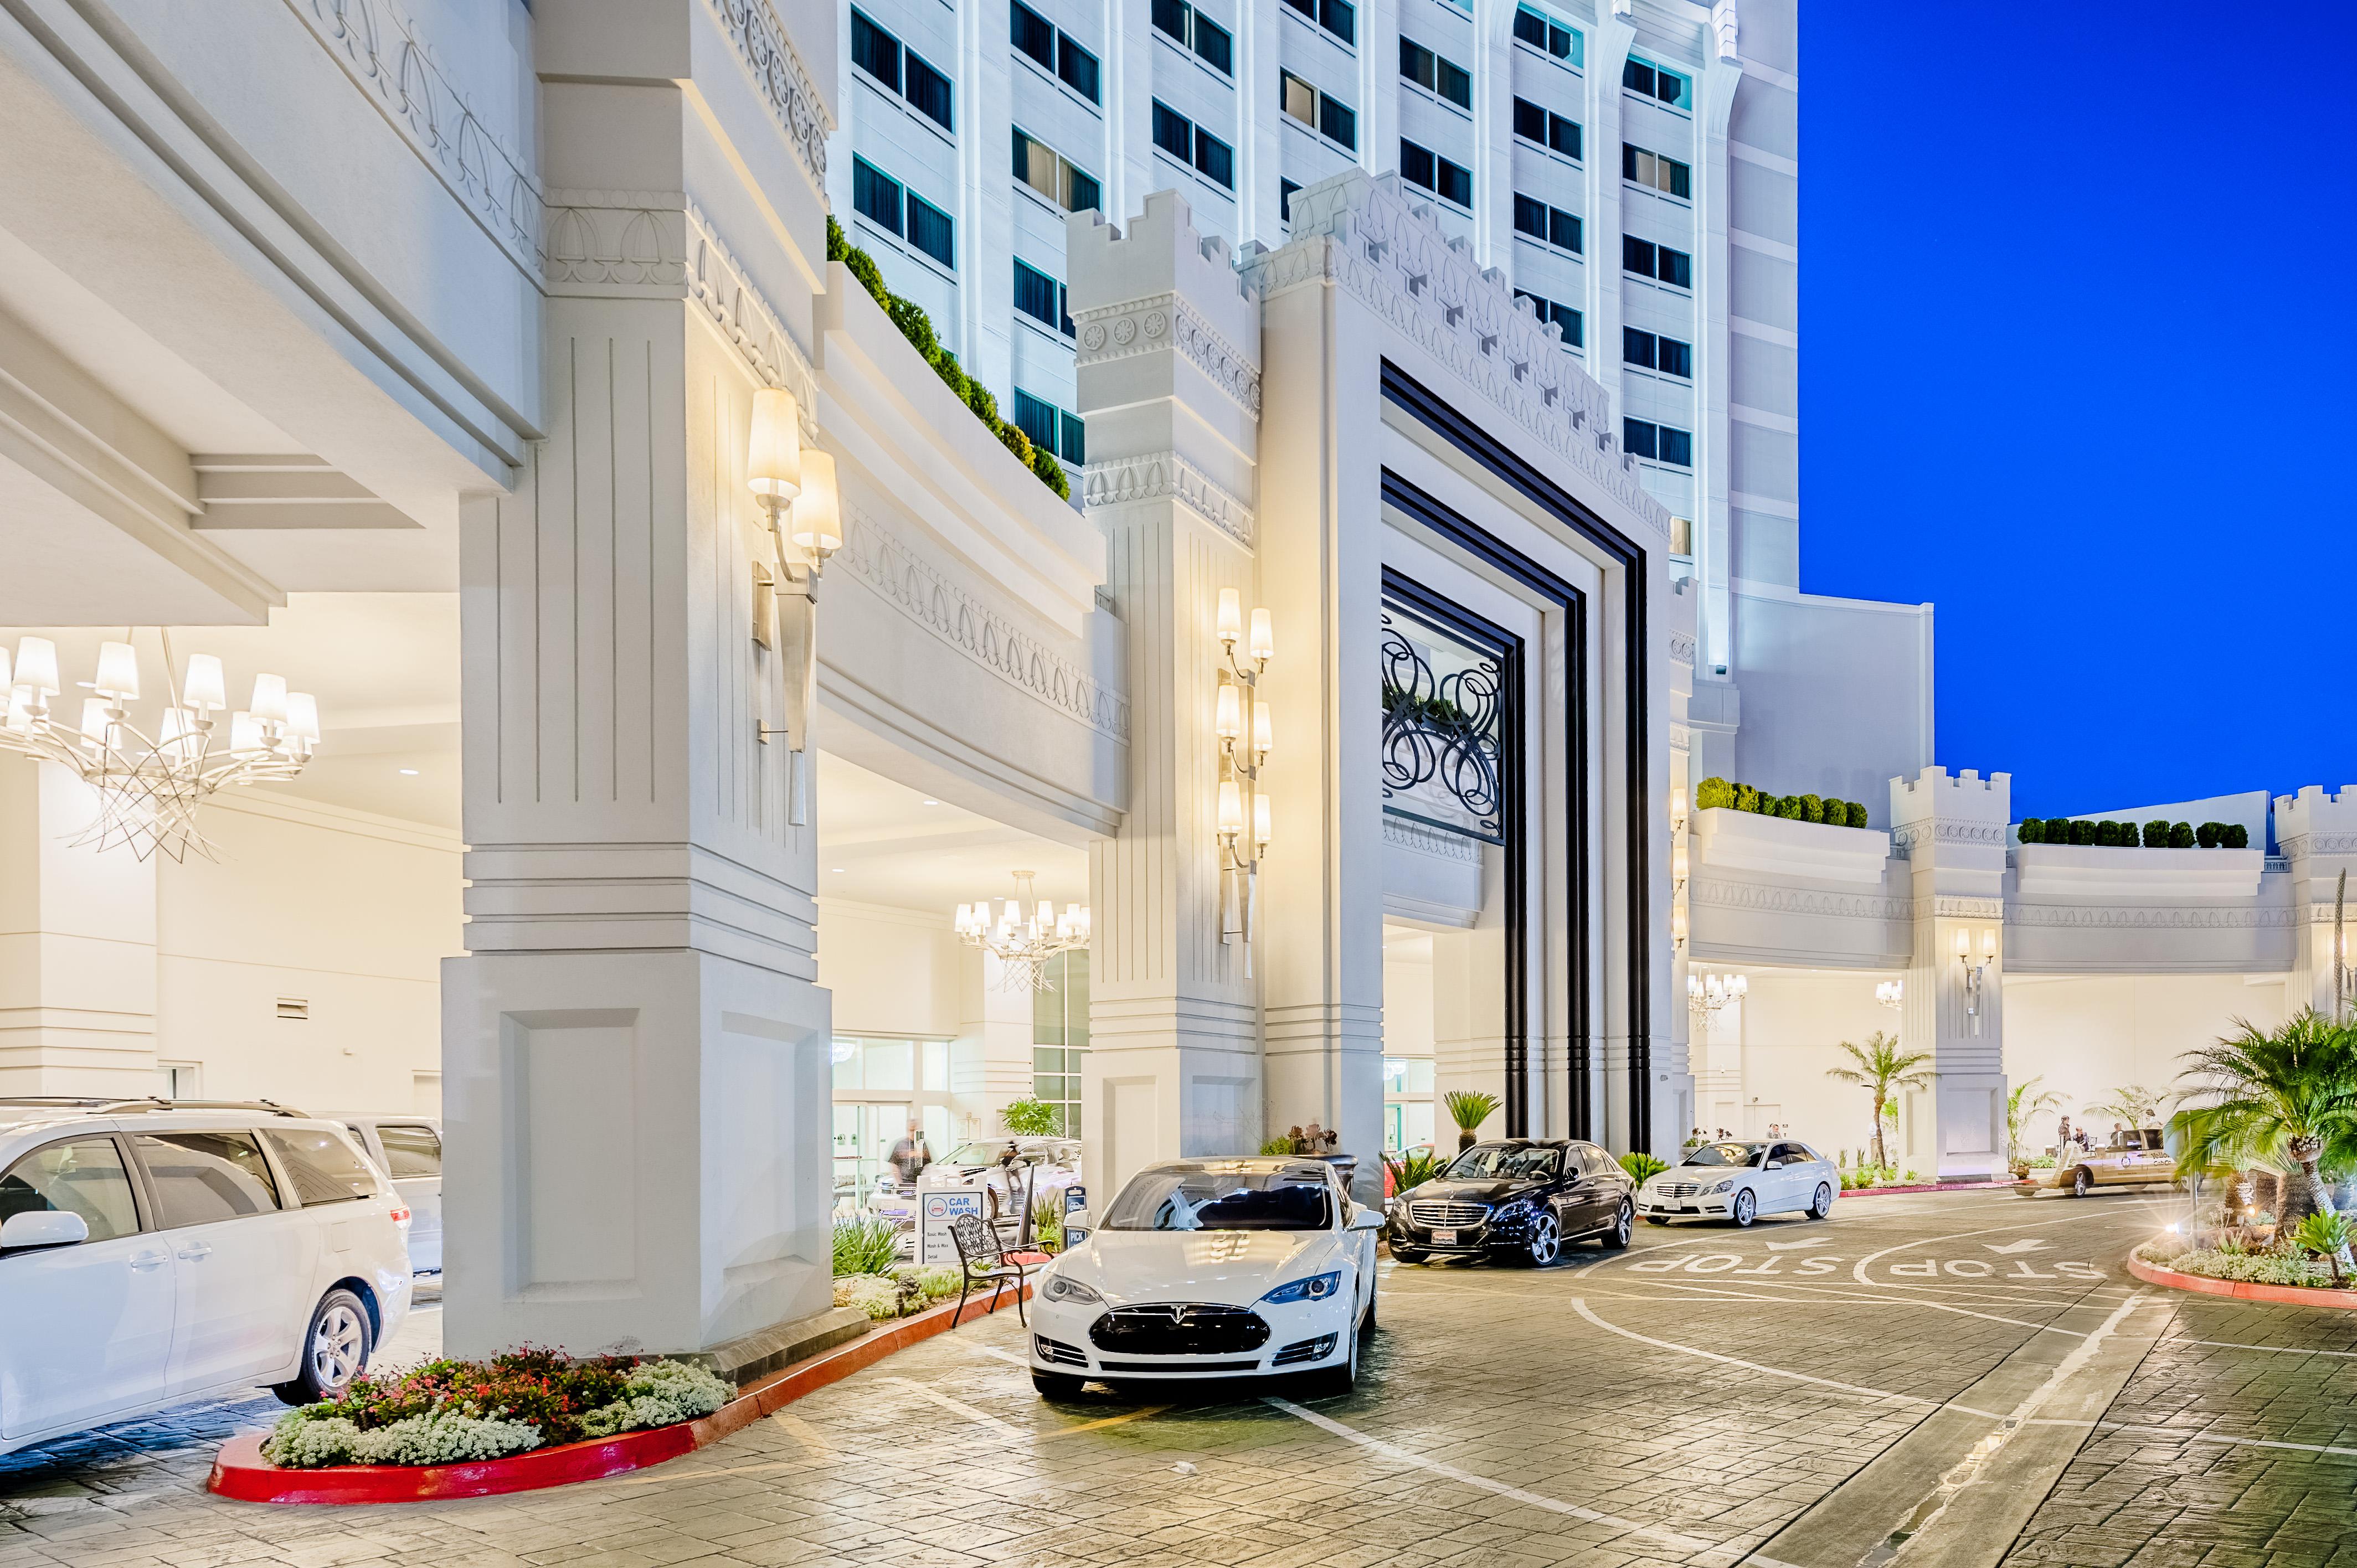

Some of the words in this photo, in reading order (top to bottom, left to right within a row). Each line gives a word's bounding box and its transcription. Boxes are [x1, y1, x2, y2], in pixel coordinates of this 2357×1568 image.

[949, 1198, 970, 1206] CAR
[949, 1207, 978, 1215] WASH
[1070, 1231, 1083, 1242] PICK
[1625, 1254, 1845, 1275] STOP
[1889, 1259, 2109, 1280] STOP
